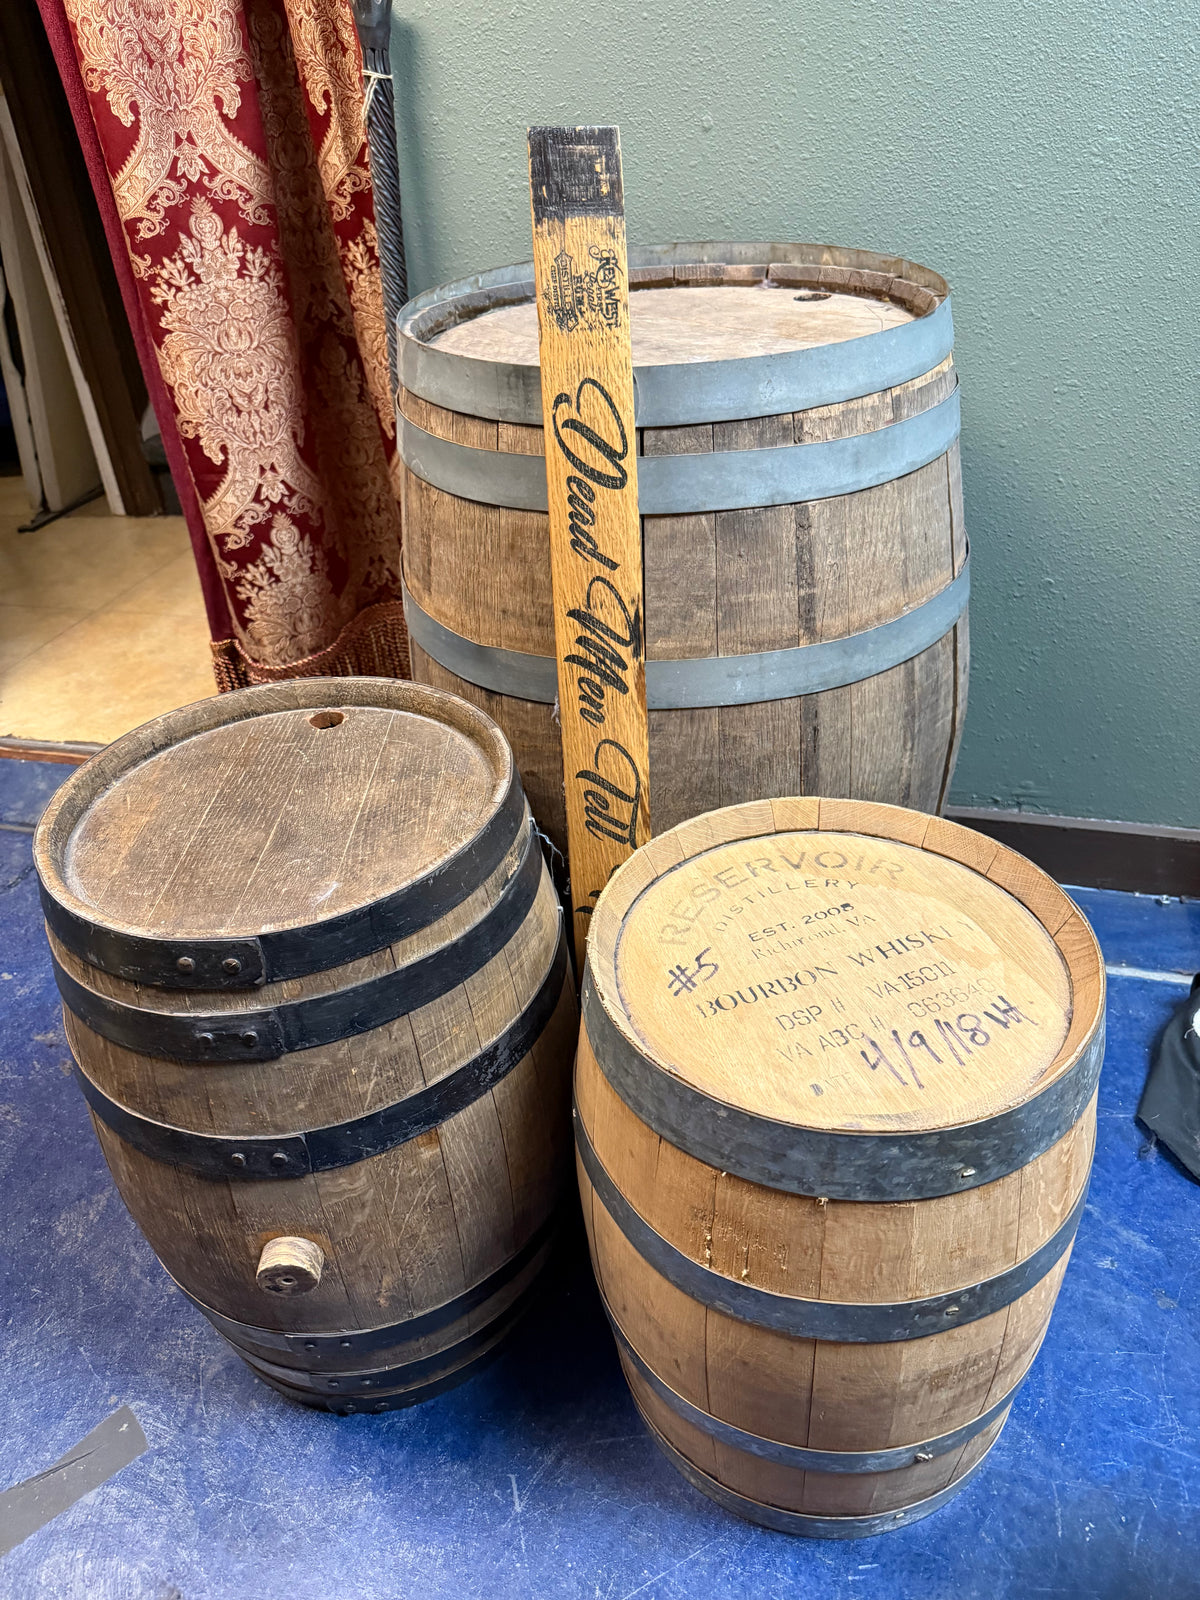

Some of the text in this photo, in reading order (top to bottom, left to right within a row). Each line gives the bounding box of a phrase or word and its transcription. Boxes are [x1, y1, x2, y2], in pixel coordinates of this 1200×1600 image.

[603, 285, 622, 330] WEST
[552, 377, 628, 572] Dead
[563, 575, 635, 729] Men
[575, 738, 642, 851] Tell
[658, 851, 905, 946] RESERVOIR
[714, 878, 860, 933] DISTILLERY
[748, 921, 796, 942] EST.
[668, 946, 719, 997] #5
[696, 961, 839, 1019] BOURBON
[775, 1005, 823, 1032] DSP
[776, 1041, 813, 1062] VA
[818, 1023, 865, 1052] ABC
